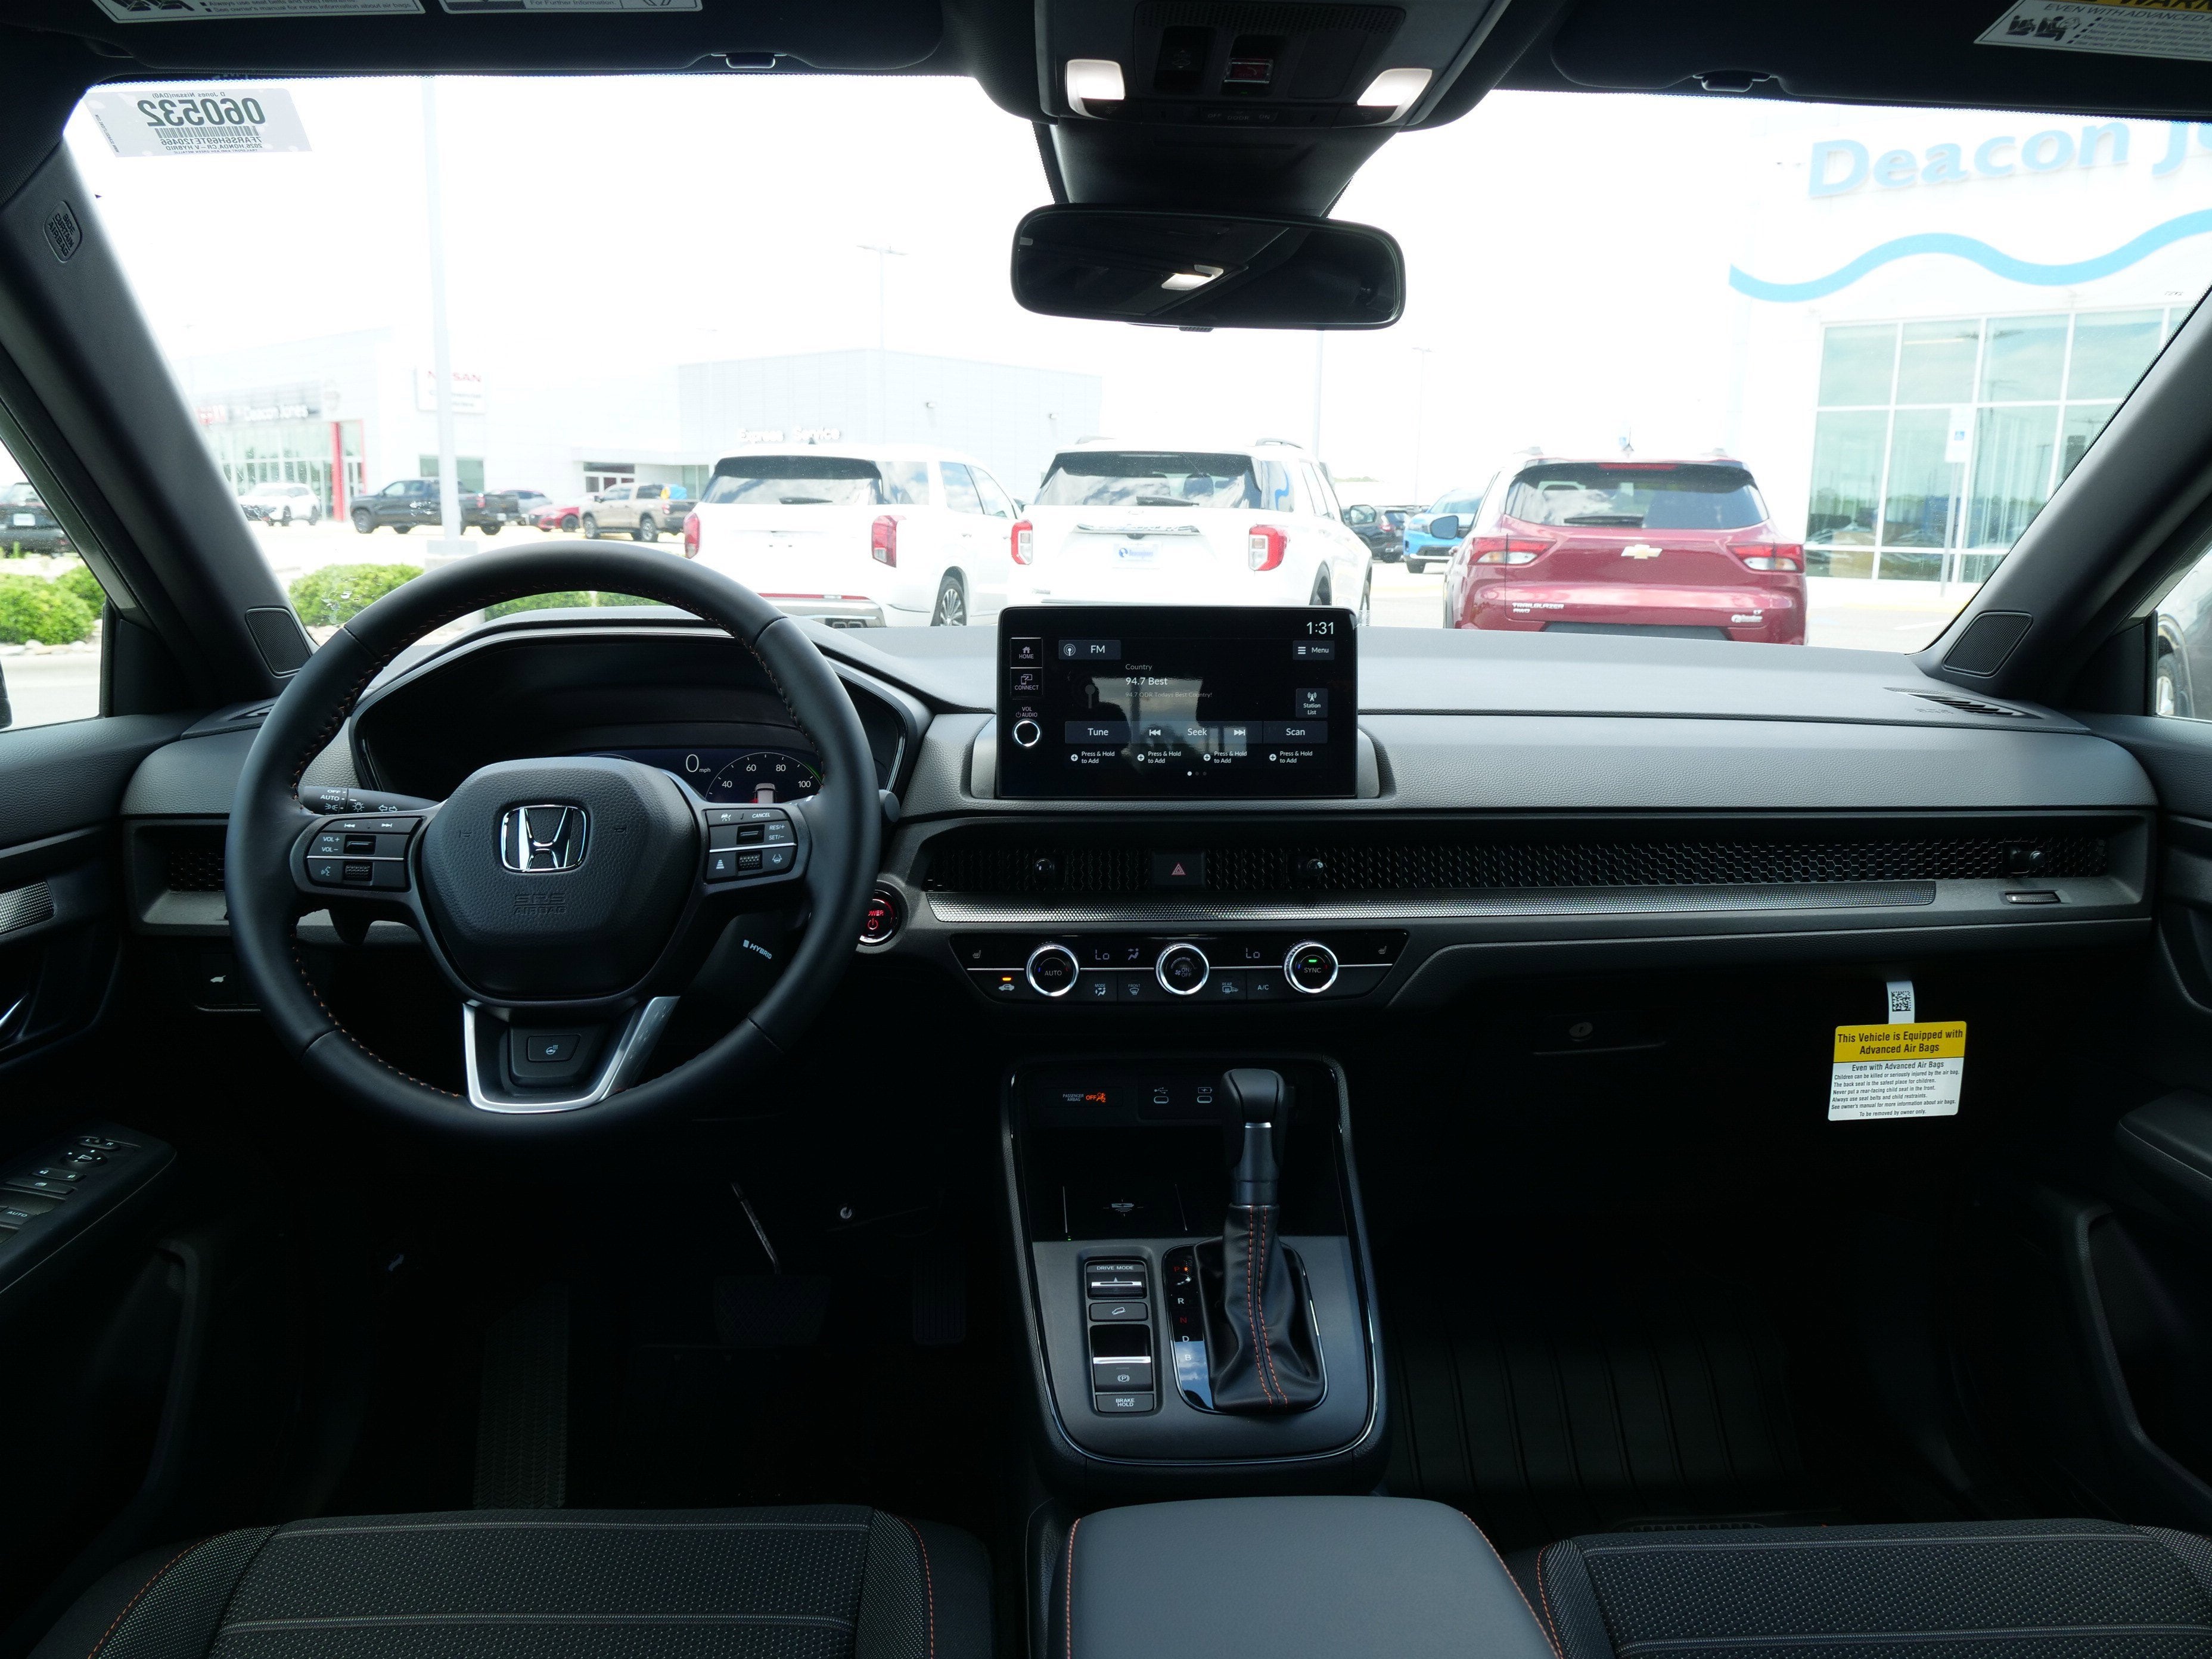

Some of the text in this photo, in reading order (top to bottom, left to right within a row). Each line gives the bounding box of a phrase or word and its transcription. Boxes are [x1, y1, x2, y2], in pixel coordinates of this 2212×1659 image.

[1807, 121, 2212, 199] Deacon J
[427, 369, 483, 383] NSAN
[1306, 622, 1334, 635] 1:31
[1090, 645, 1106, 654] FM
[1126, 677, 1168, 685] 94.7 Best
[685, 754, 699, 772] 0
[513, 893, 566, 904] SRS
[512, 906, 567, 915] AIRBAG
[749, 942, 772, 959] HYBRID
[1095, 949, 1110, 961] Lo
[1245, 947, 1260, 959] Lo
[1838, 1029, 1963, 1043] This Vehicle is Equipped with
[1859, 1043, 1940, 1055] Advanced Air Bags
[1884, 1061, 1916, 1070] Advanced
[1928, 1061, 1944, 1069] Bags
